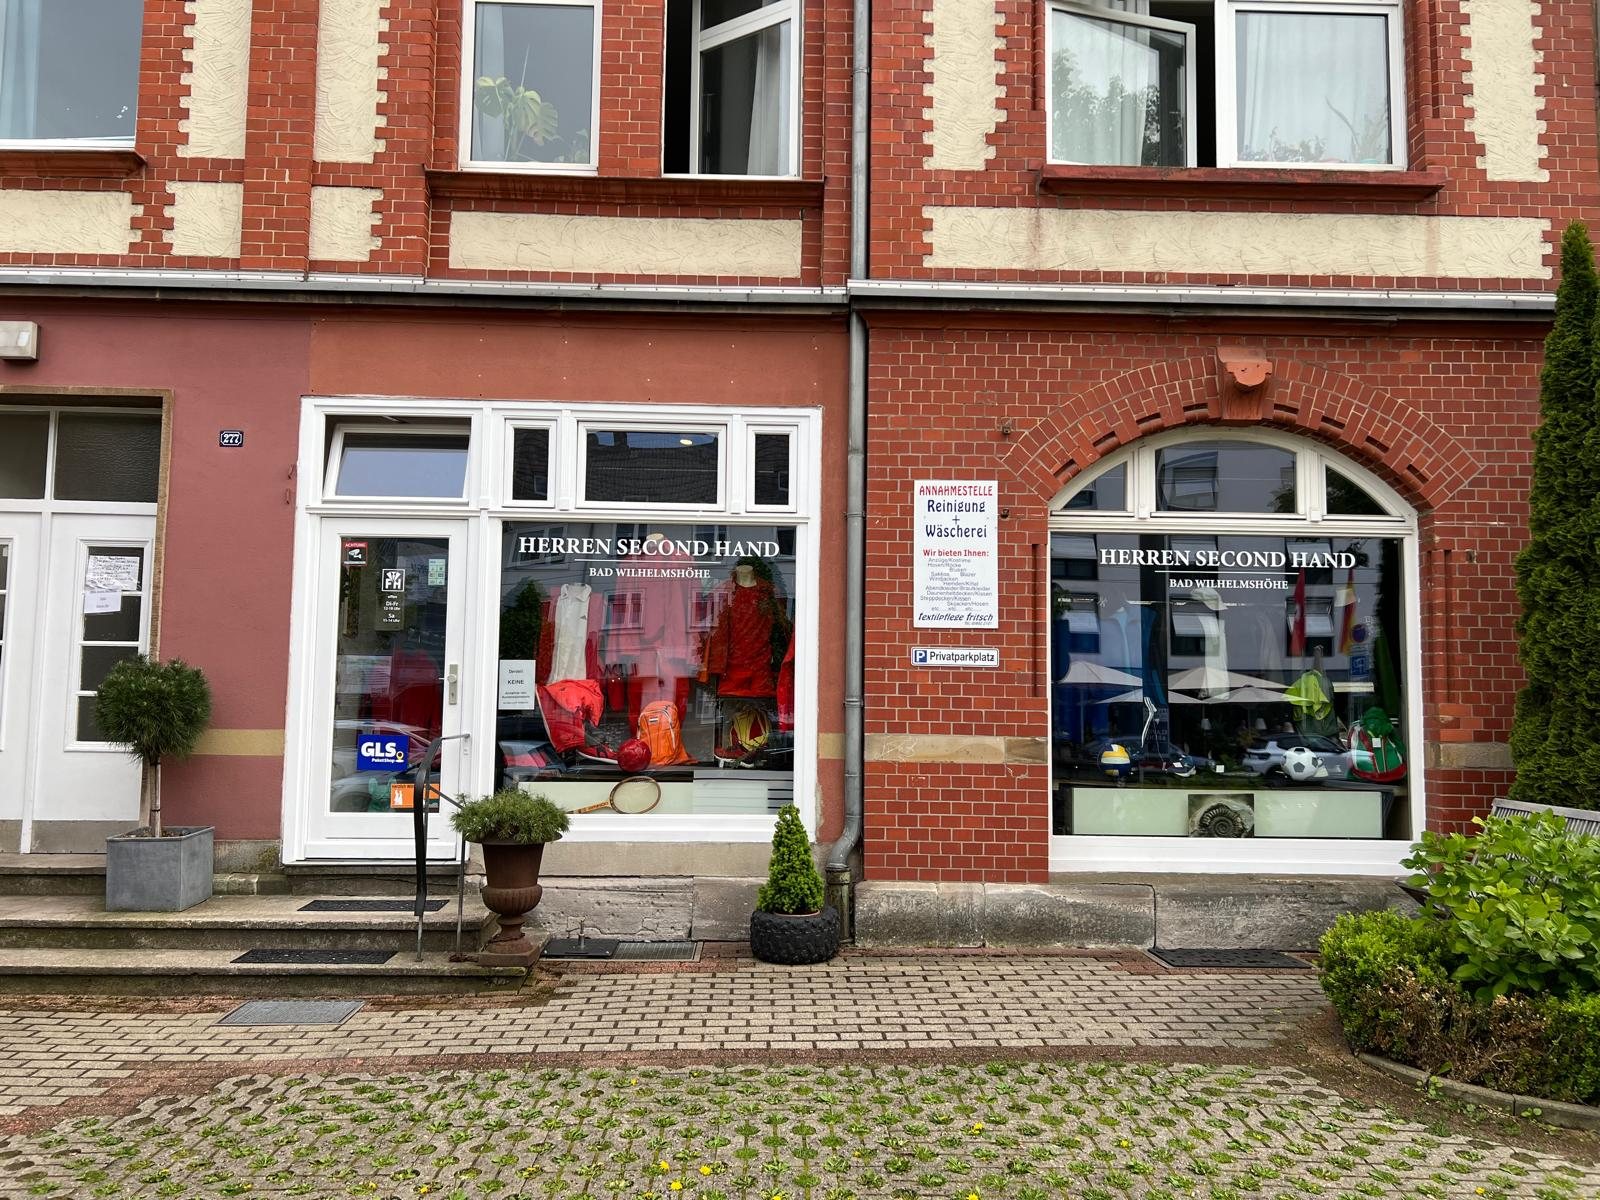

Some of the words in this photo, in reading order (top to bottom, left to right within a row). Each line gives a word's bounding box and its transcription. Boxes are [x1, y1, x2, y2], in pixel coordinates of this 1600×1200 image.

[223, 433, 240, 444] 277
[919, 485, 993, 497] ANNAHMESTELLE
[927, 499, 986, 513] Reinigung
[925, 524, 987, 538] Wäscherei
[518, 536, 612, 555] HERREN
[616, 538, 709, 557] SECOND
[714, 540, 780, 558] HAND
[923, 549, 936, 557] Wir
[938, 549, 963, 557] bieten
[964, 549, 989, 557] Ihnen:
[1100, 548, 1190, 567] HERREN
[1195, 550, 1286, 568] SECOND
[1291, 551, 1356, 569] HAND
[589, 567, 613, 577] BAD
[616, 566, 711, 578] WILHELMSHÖHE
[385, 578, 401, 590] FH
[1169, 578, 1193, 588] BAD
[1194, 577, 1289, 590] WILHELMSHÖHE
[966, 612, 994, 621] fritsch
[929, 651, 995, 663] Privatparkplatz
[361, 741, 397, 758] GLS
